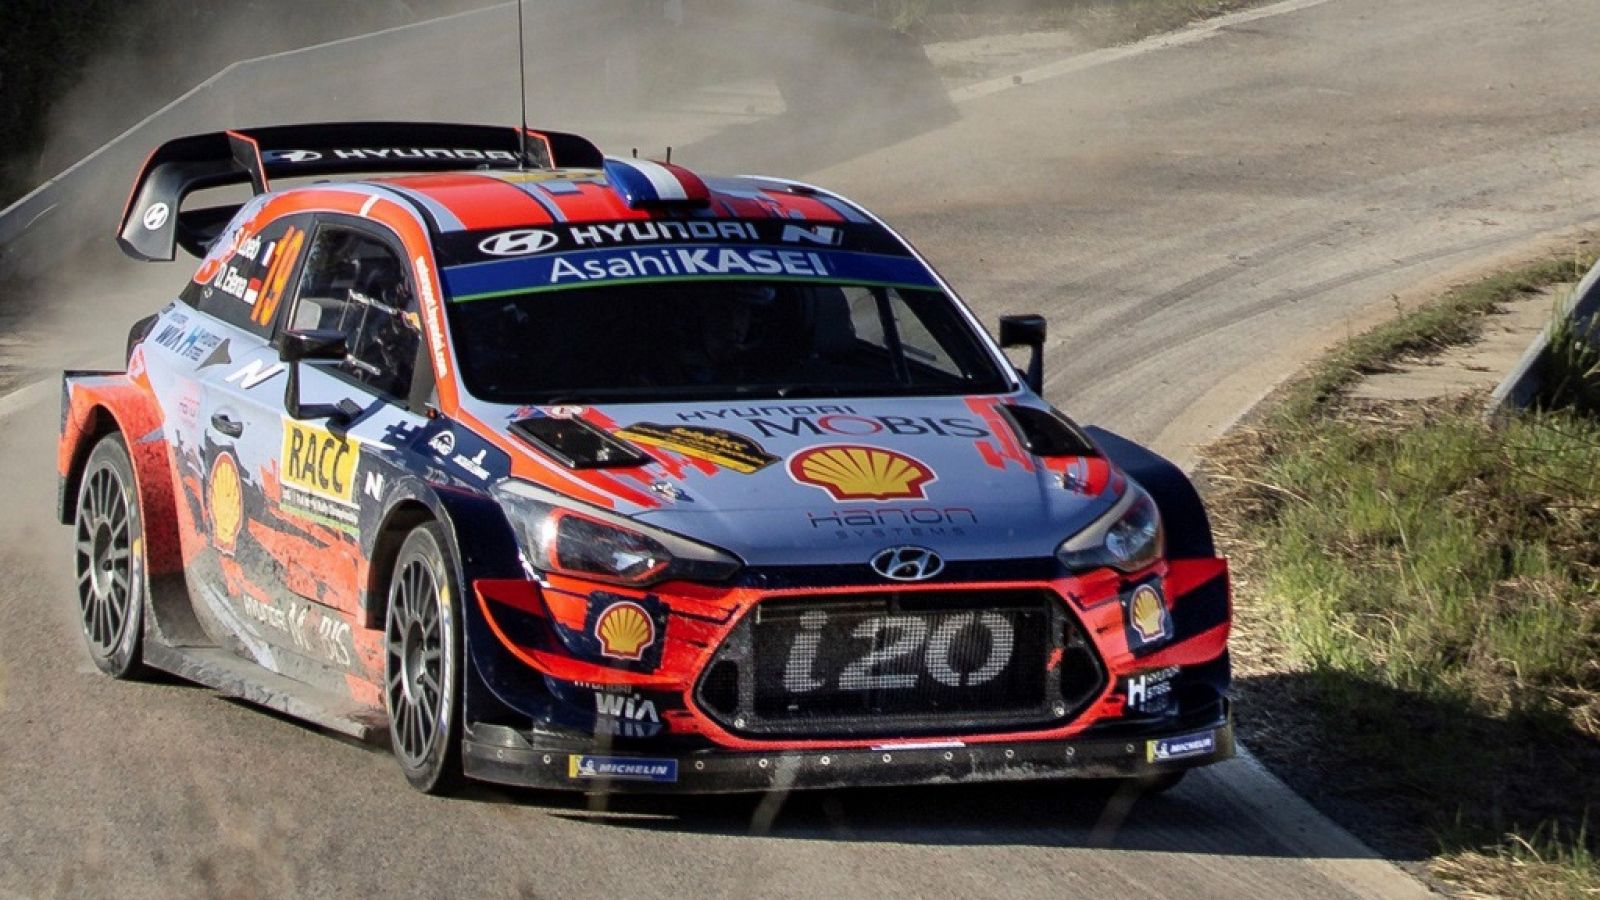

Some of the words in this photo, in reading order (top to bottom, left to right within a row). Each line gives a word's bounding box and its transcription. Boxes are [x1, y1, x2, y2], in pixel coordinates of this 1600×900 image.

[570, 221, 759, 245] HYUNDAI
[251, 225, 305, 326] 19
[225, 359, 286, 389] N
[676, 404, 857, 422] HYUNDAI
[748, 415, 989, 438] MOBIS
[288, 427, 350, 494] RACC
[364, 471, 385, 502] N
[835, 526, 966, 539] SYSTEMS
[289, 601, 351, 665] MBIS
[599, 763, 668, 776] MICHELIN
